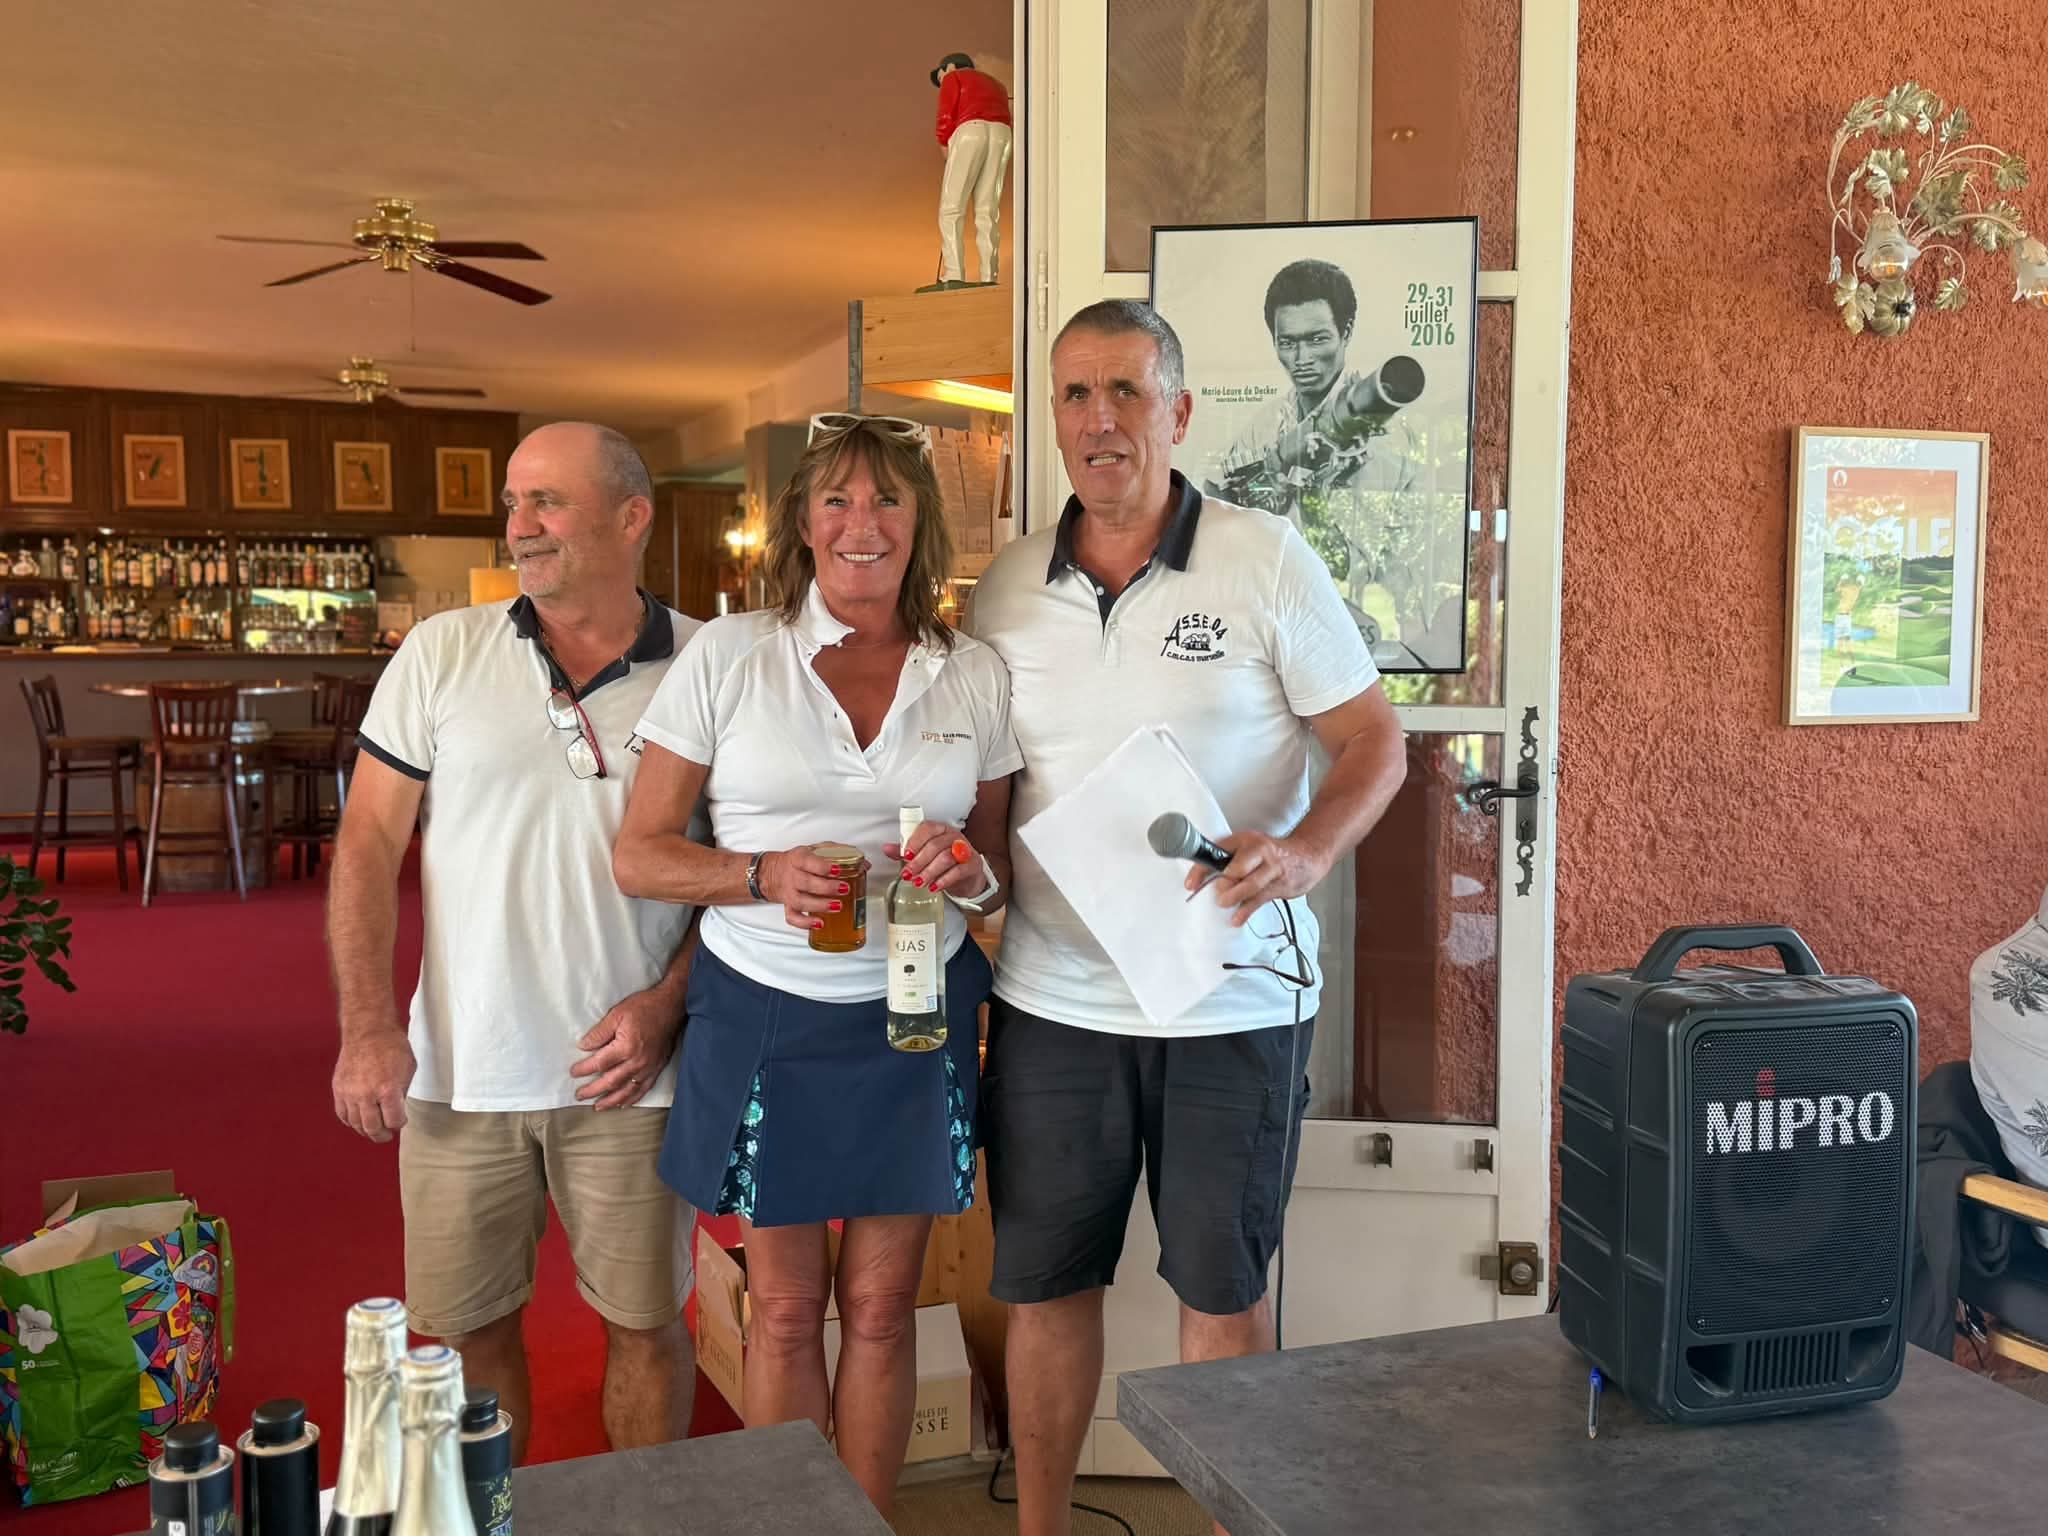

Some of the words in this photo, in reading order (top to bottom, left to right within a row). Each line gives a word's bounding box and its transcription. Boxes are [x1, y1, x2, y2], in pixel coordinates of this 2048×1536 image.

[1408, 283, 1453, 306] 29-31
[1405, 301, 1448, 328] juillet
[1411, 323, 1454, 346] 2016
[1244, 385, 1252, 395] de
